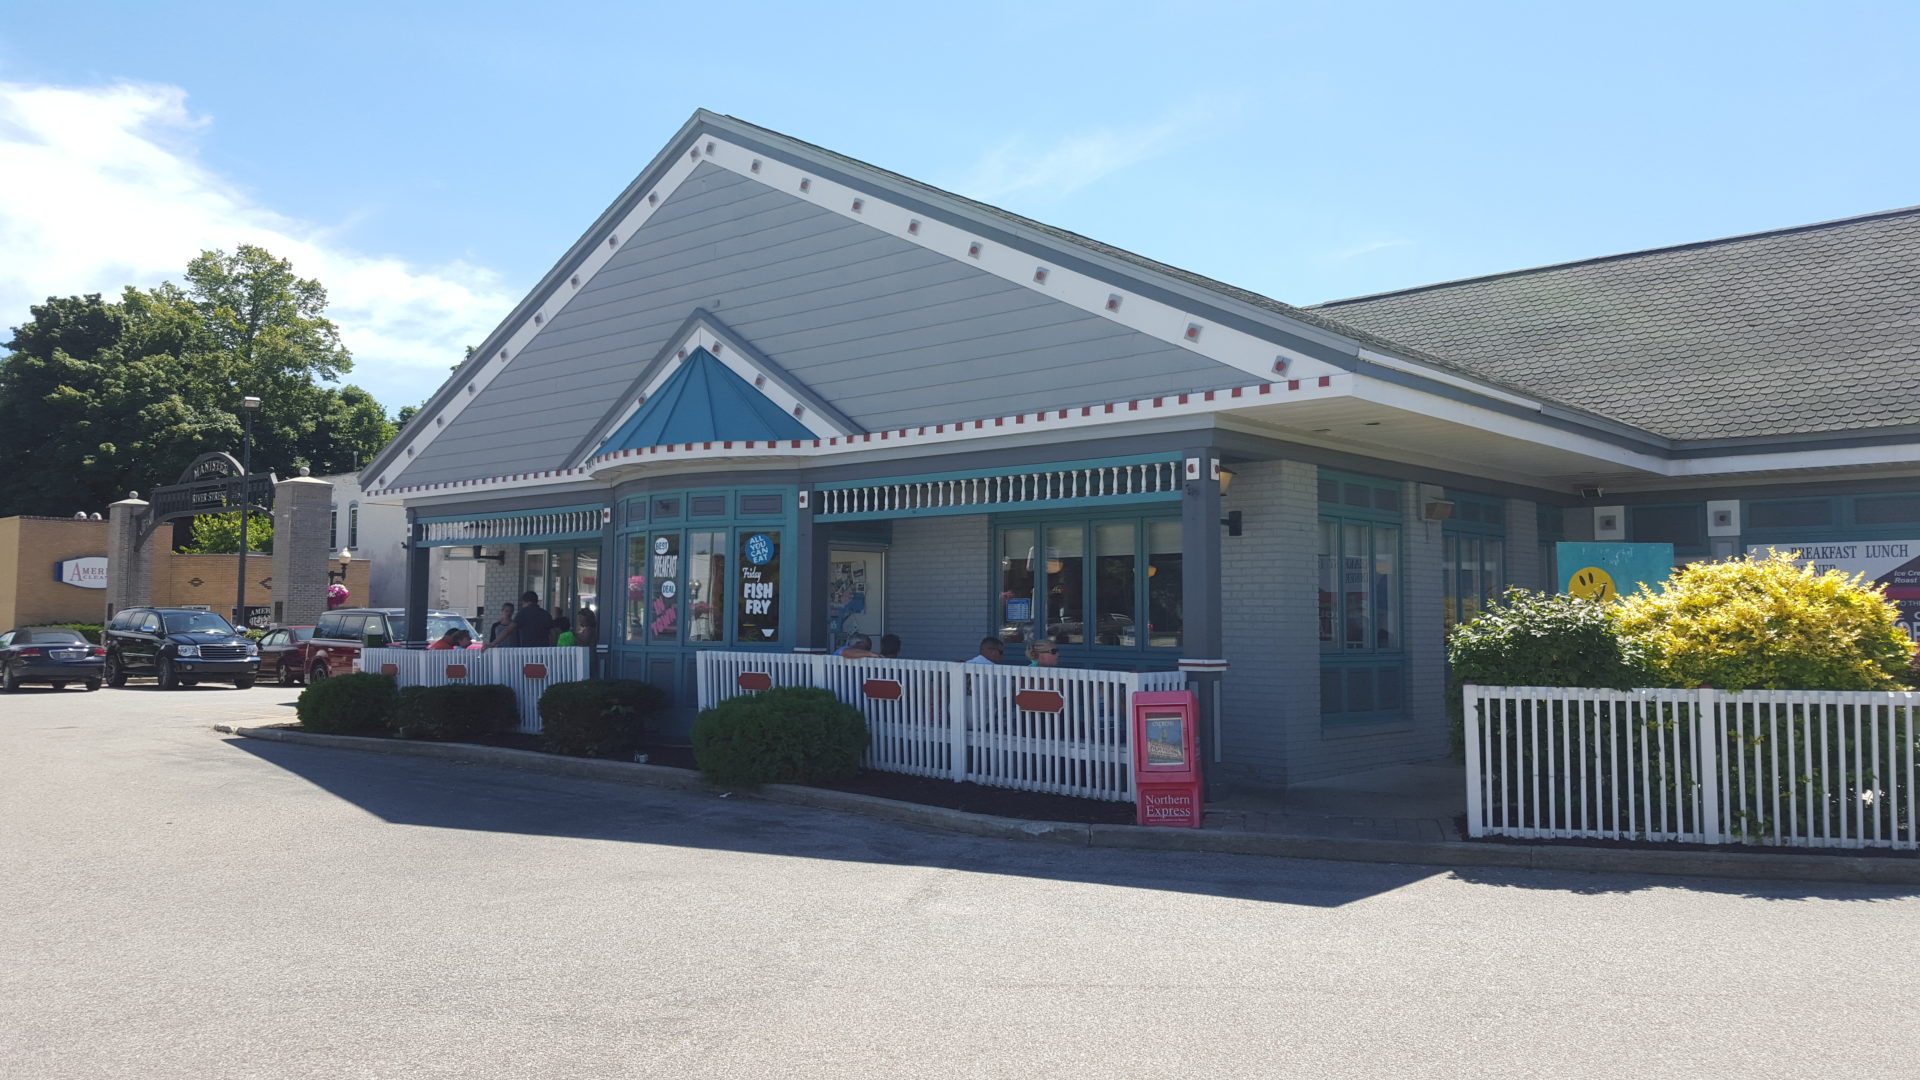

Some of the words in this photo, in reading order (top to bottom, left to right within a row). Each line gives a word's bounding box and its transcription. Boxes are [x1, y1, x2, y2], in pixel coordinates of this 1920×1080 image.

[192, 493, 207, 504] RIVER
[656, 541, 668, 550] BEST
[749, 535, 764, 545] ALL
[750, 541, 766, 551] YOU
[1866, 544, 1908, 559] LUNCH
[750, 547, 768, 557] CAN
[753, 554, 768, 564] EAT
[654, 555, 677, 578] BREAKFAST
[742, 566, 762, 583] Friday
[662, 585, 674, 594] DEAL
[743, 582, 773, 599] FISH
[745, 599, 771, 615] FRY
[651, 607, 676, 636] TOWN
[1145, 794, 1190, 805] Northern
[1146, 805, 1191, 819] Express
